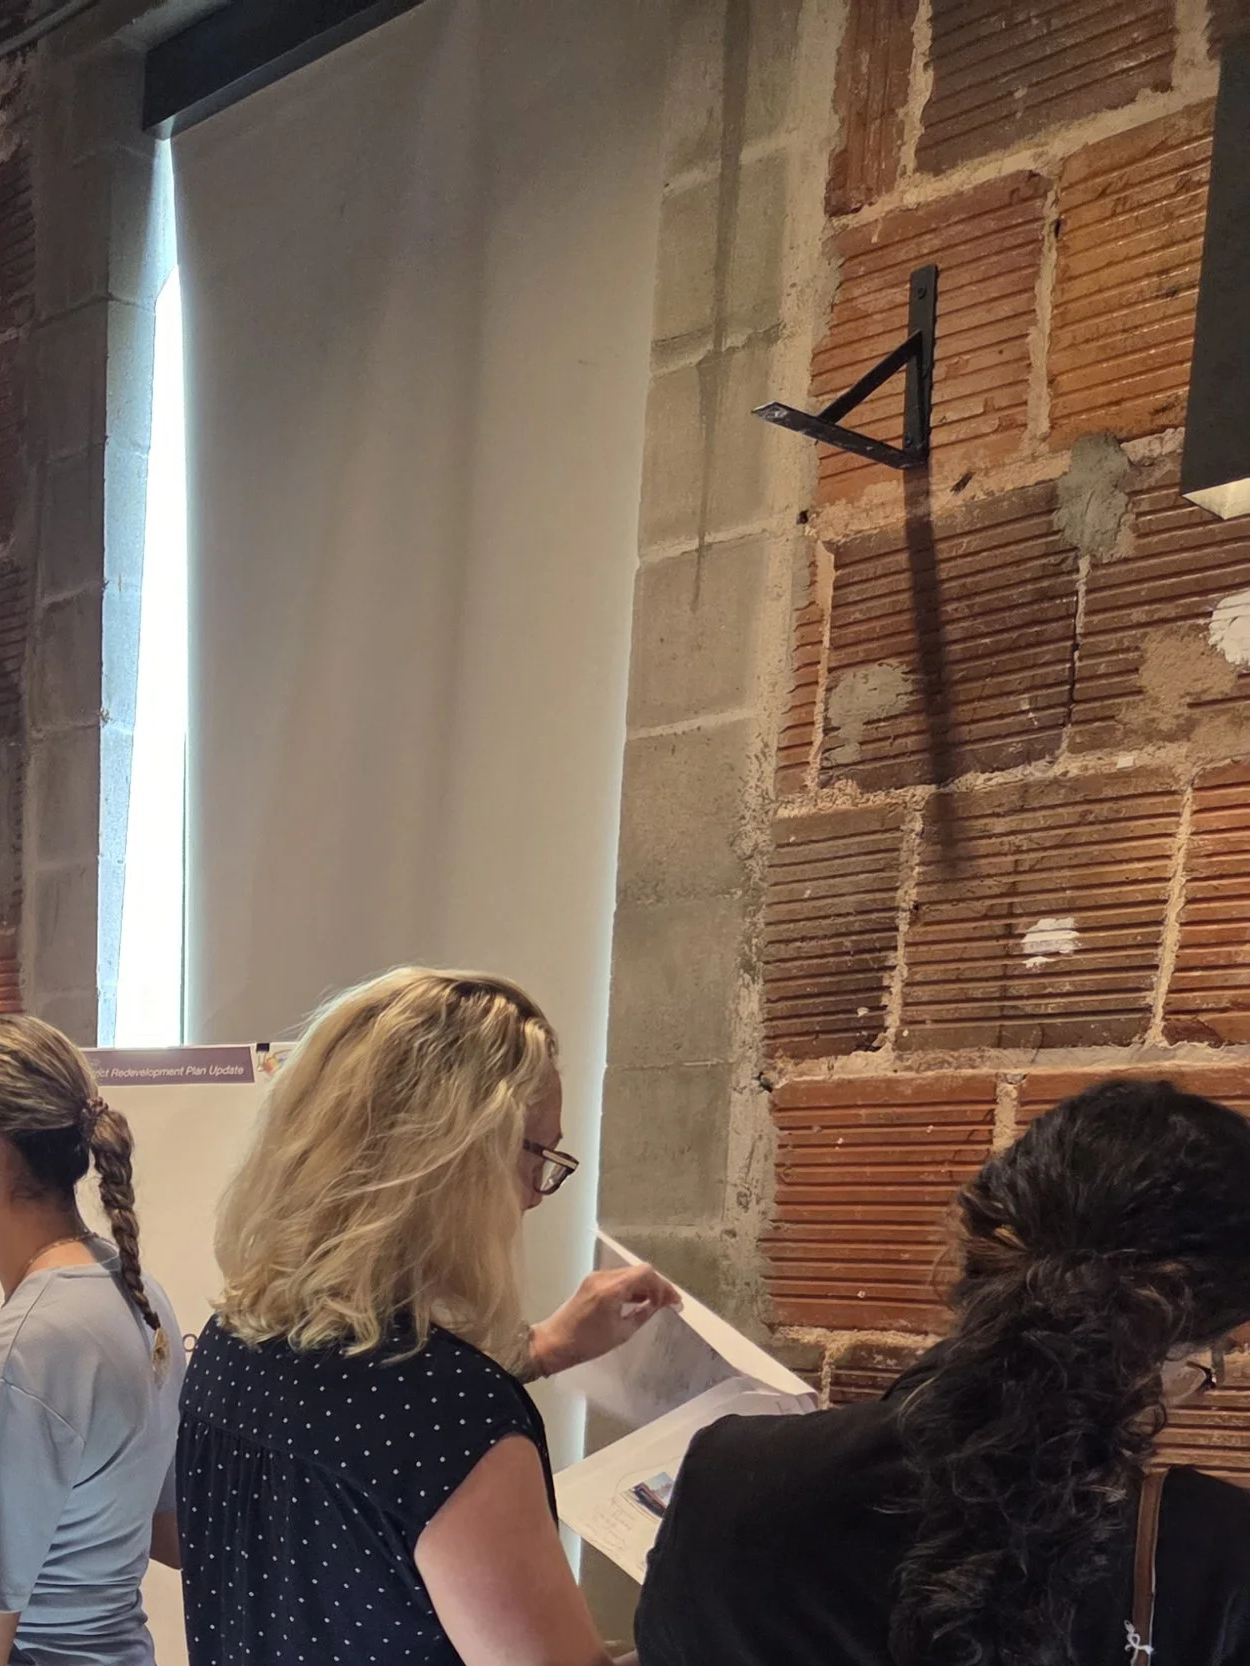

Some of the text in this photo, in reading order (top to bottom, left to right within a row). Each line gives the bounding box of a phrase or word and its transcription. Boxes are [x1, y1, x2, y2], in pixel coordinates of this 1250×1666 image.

[111, 1066, 183, 1079] Redevelopment
[185, 1065, 207, 1076] Plan
[208, 1064, 244, 1077] Update
